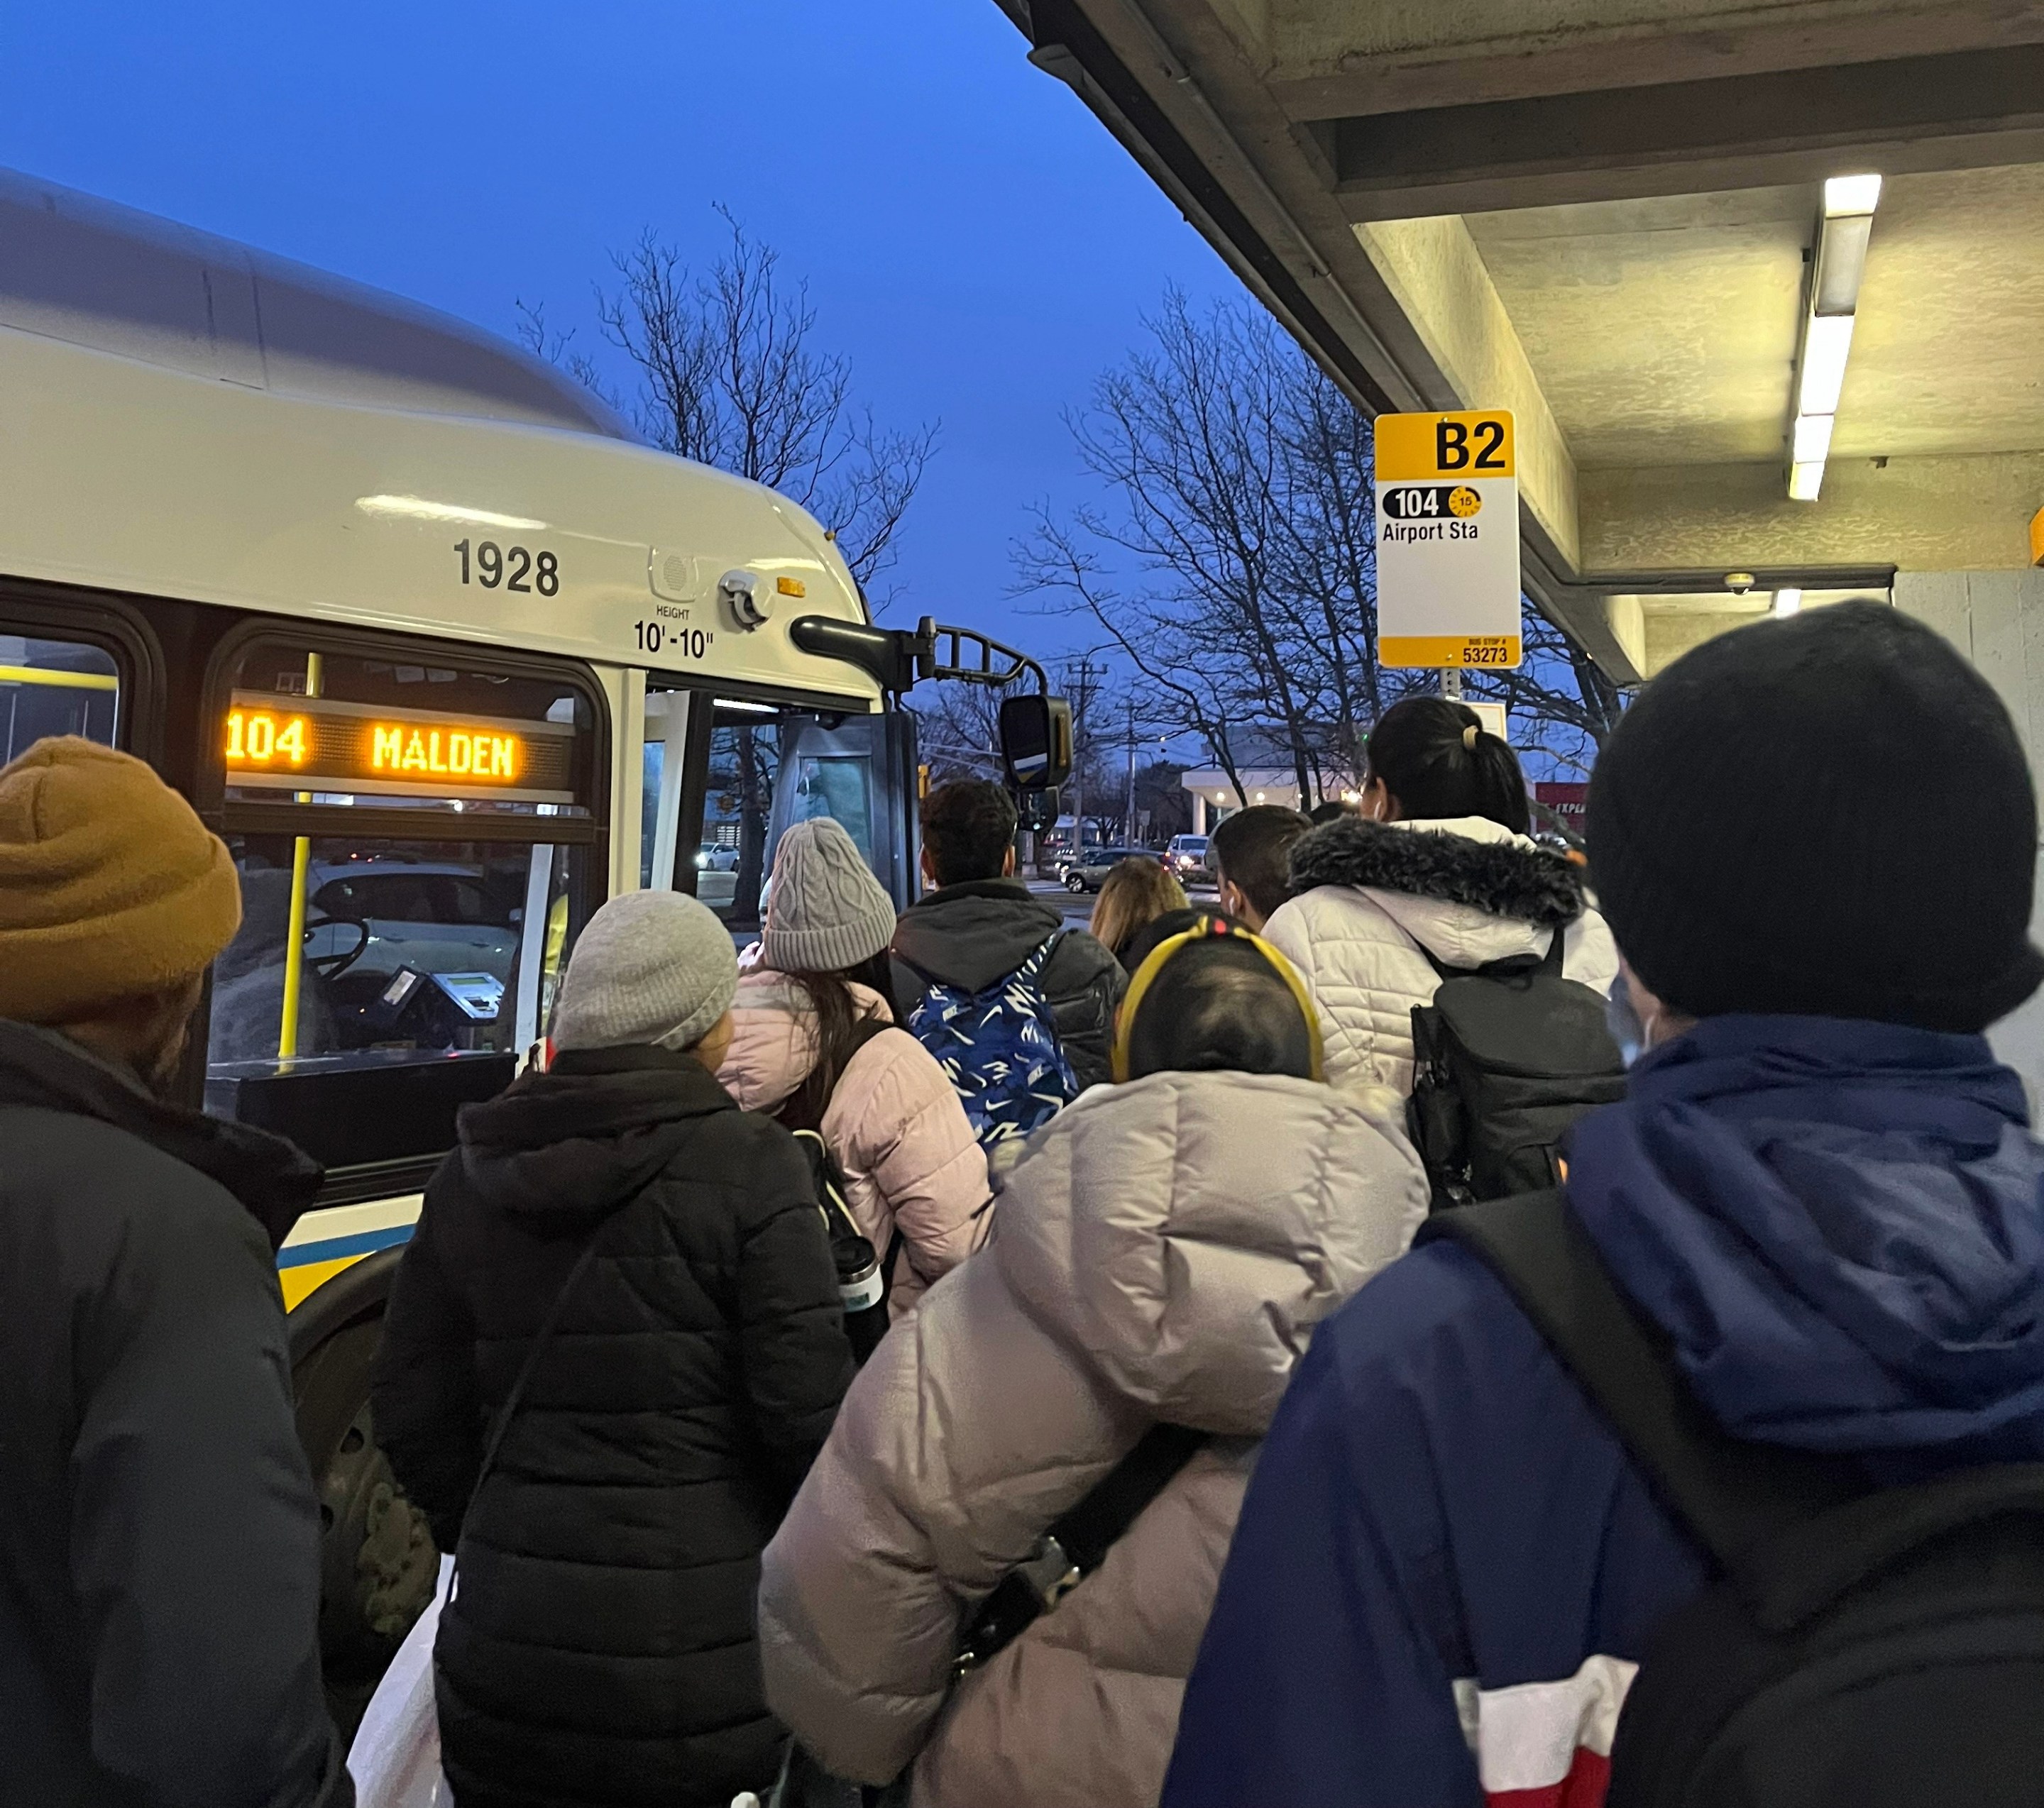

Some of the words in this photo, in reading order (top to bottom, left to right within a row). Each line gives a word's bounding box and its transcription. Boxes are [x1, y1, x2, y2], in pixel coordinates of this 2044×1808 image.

[1436, 421, 1506, 470] B2
[1395, 489, 1439, 517] 104
[1459, 496, 1472, 507] 15
[1383, 522, 1444, 544] Airport
[1449, 522, 1478, 539] Sta
[453, 538, 560, 597] 1928
[656, 605, 690, 620] HEIGHT
[634, 619, 714, 659] 10'-10"
[1463, 647, 1507, 663] 53273
[226, 712, 307, 764] 104
[372, 724, 515, 777] MALDEN
